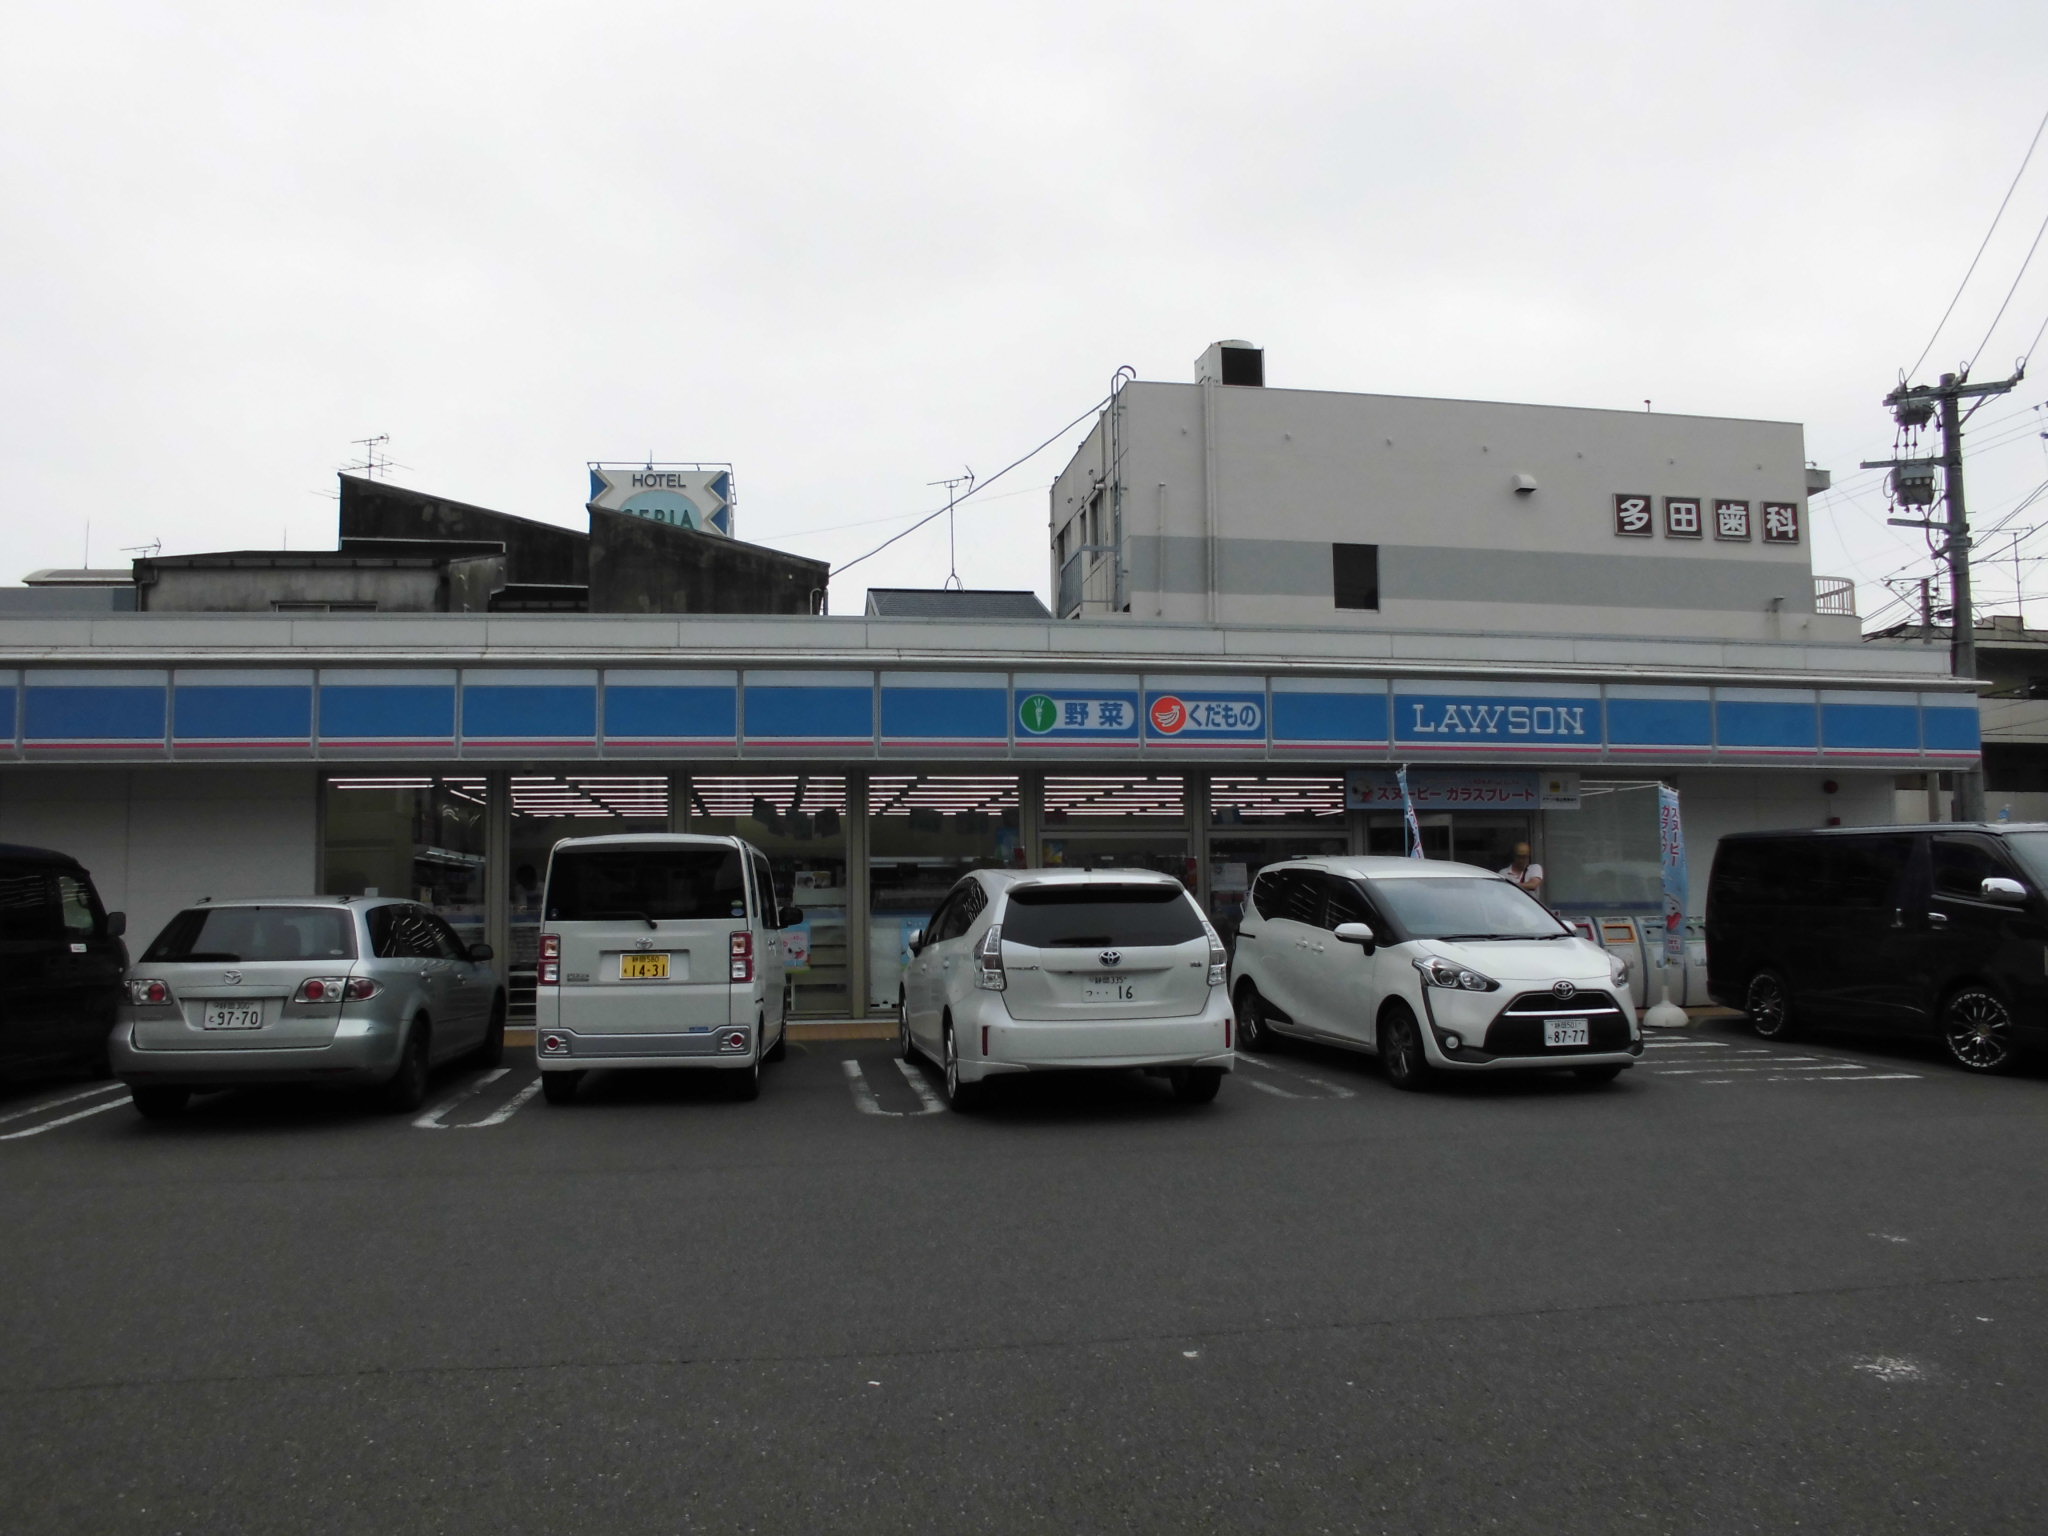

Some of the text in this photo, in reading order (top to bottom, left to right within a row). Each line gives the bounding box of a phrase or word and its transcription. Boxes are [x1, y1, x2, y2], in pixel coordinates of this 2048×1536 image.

[632, 474, 686, 489] HOTEL
[1619, 499, 1797, 538] 多田歯科
[1064, 701, 1125, 728] 野菜
[1188, 703, 1256, 728] くだもの
[1412, 703, 1585, 735] LAWSON
[1446, 787, 1535, 802] ガラスプレート
